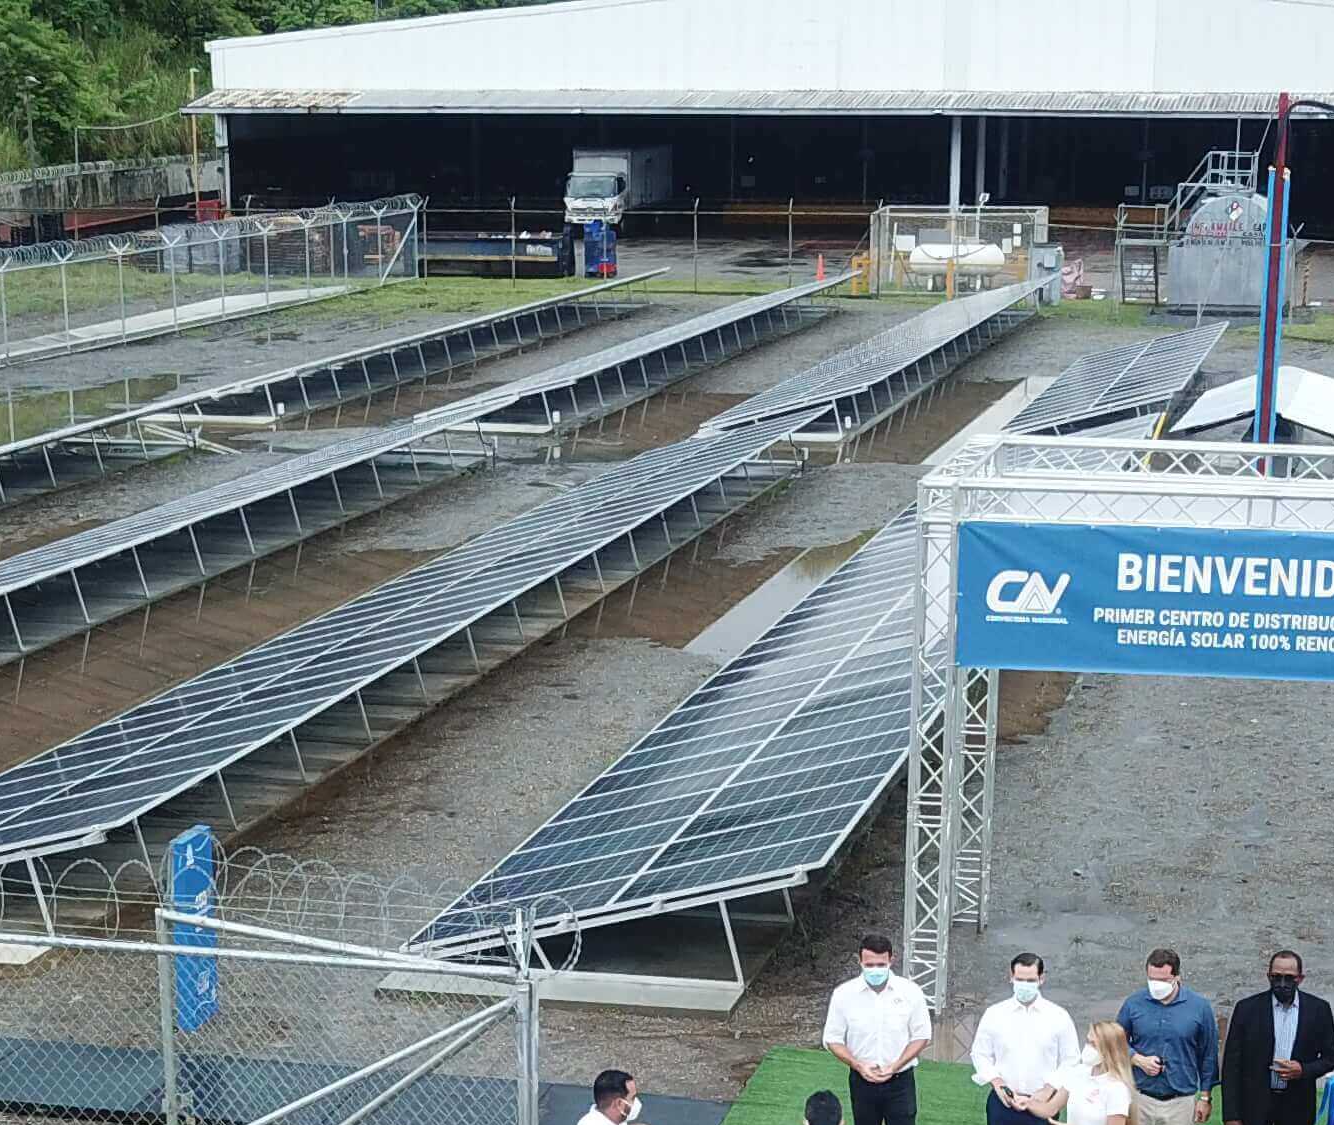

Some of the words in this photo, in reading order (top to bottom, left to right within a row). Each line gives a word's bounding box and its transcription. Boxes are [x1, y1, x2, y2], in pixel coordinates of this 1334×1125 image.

[1093, 607, 1155, 625] PRIMER
[1159, 609, 1225, 628] CENTRO
[1228, 612, 1250, 629] DE
[1117, 627, 1186, 647] ENERGÍA
[1190, 631, 1245, 649] SOLAR
[1250, 634, 1291, 651] 100%
